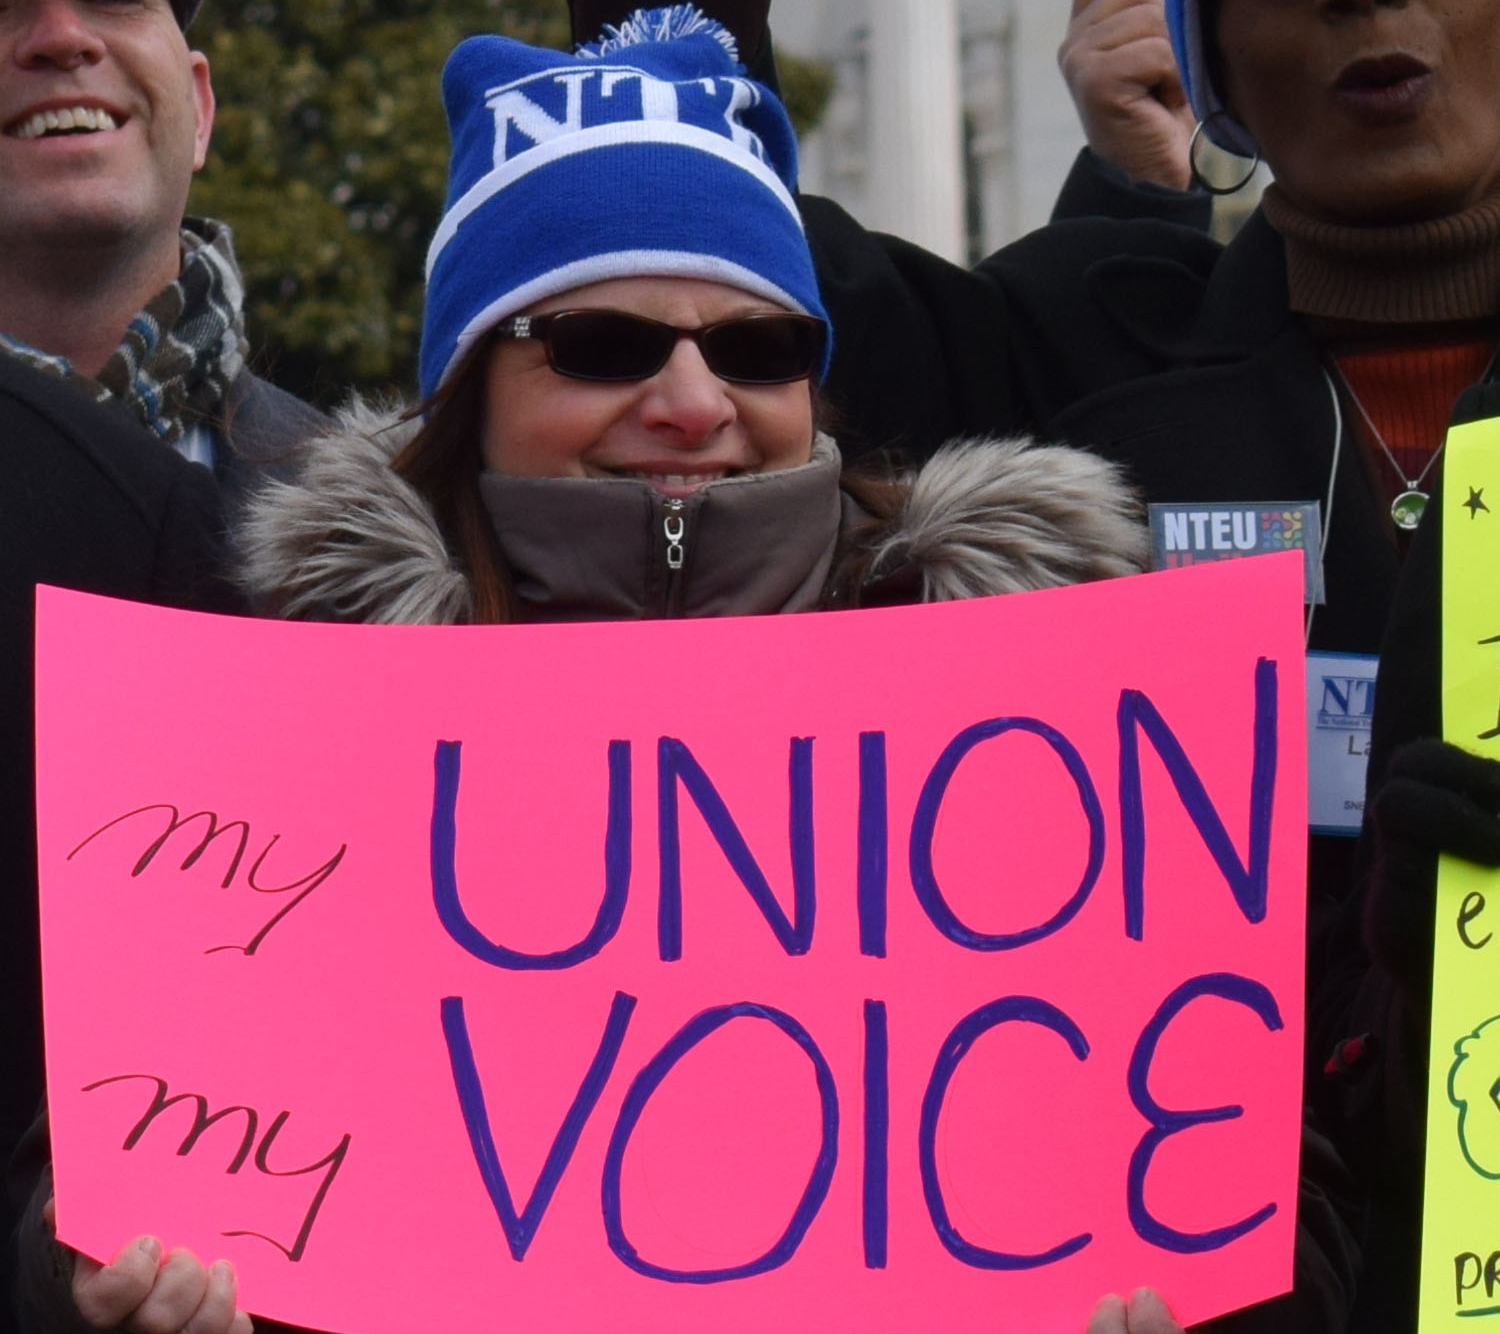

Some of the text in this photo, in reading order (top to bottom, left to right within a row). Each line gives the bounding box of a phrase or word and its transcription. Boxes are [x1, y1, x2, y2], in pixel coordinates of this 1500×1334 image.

[1164, 511, 1257, 551] NTEU
[429, 654, 1278, 971] UNION
[439, 972, 1285, 1285] VOICE
